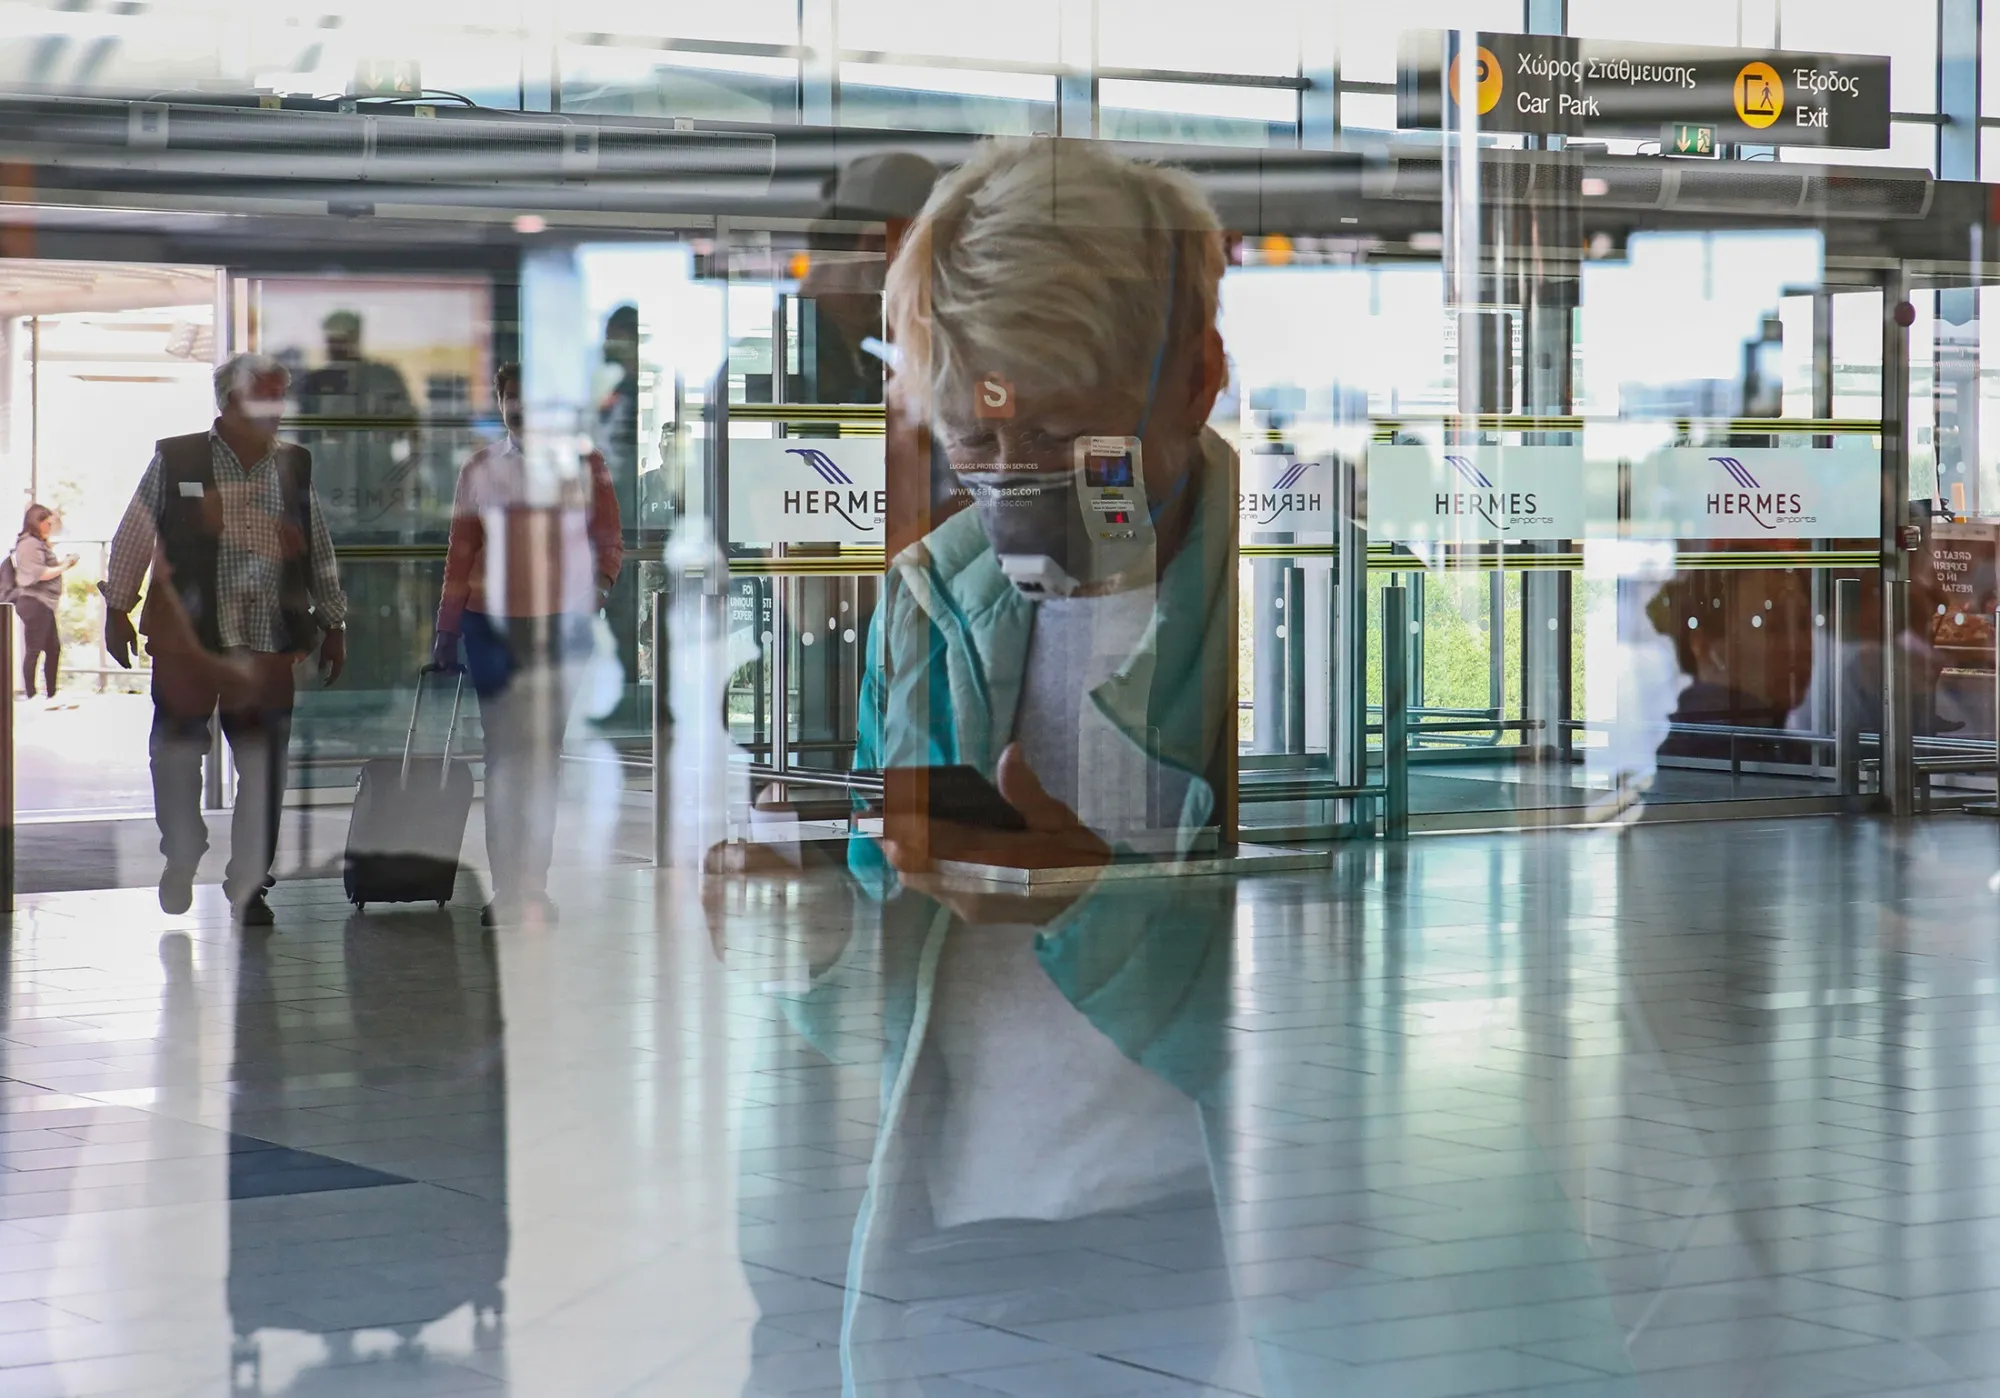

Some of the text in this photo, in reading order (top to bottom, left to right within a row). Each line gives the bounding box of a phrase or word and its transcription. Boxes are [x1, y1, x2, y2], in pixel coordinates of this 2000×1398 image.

[1517, 53, 1582, 82] Χώρος
[1587, 57, 1697, 89] Στάθμευσης
[1792, 68, 1859, 97] Έξοδος
[1517, 91, 1600, 116] Car Park
[1796, 106, 1828, 128] Exit
[983, 381, 1007, 407] S
[784, 491, 887, 530] HERME
[1436, 493, 1537, 530] HERMES
[1510, 516, 1554, 525] airports
[1707, 493, 1801, 529] HERMES
[1776, 516, 1817, 524] airports
